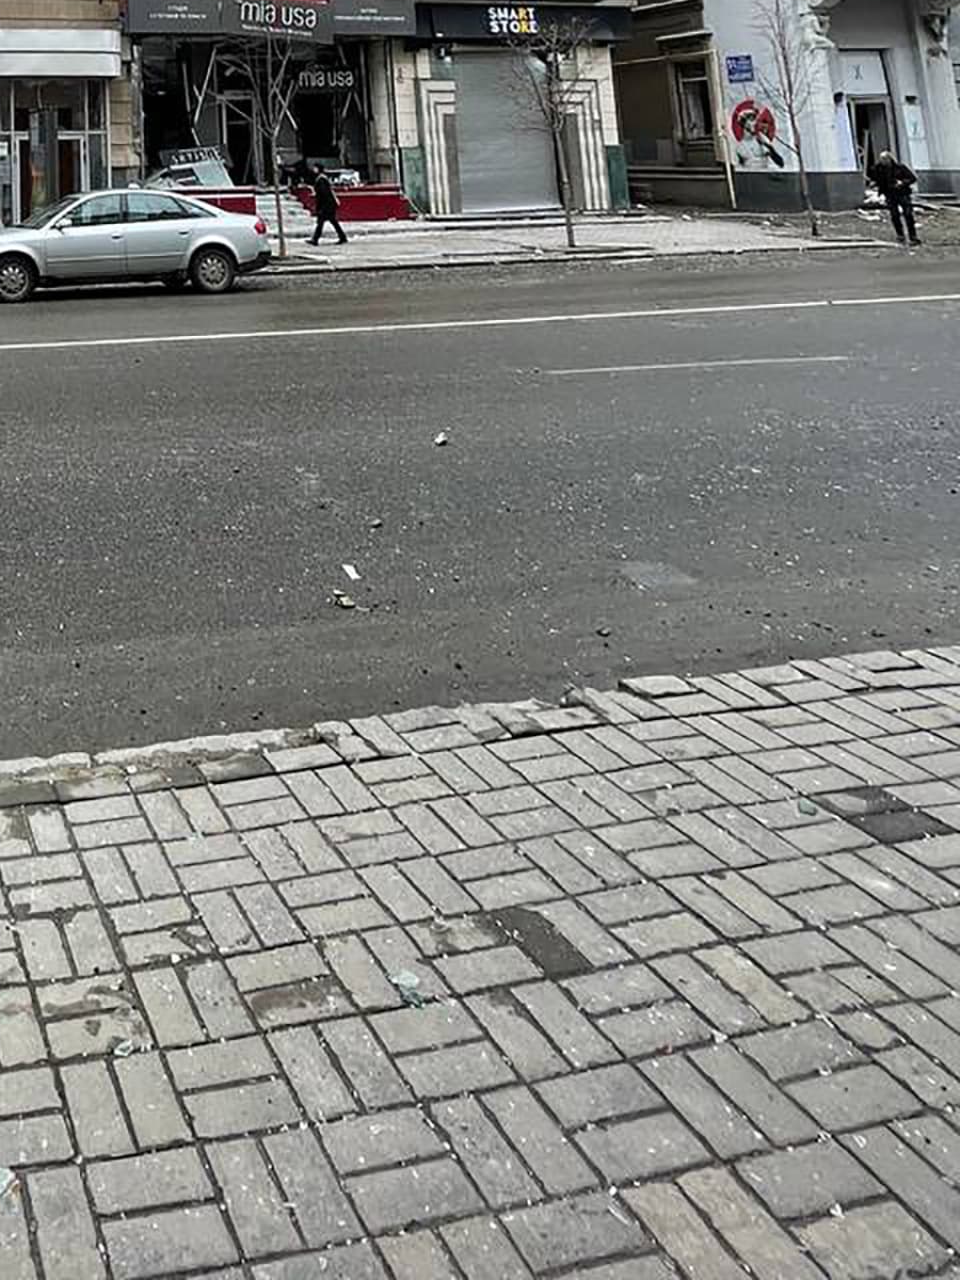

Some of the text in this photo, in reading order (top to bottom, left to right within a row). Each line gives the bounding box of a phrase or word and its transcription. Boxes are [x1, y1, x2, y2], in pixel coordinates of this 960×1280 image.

[240, 0, 317, 28] mia usa
[487, 7, 535, 20] SMART
[489, 20, 539, 34] STORE
[327, 70, 354, 87] usa
